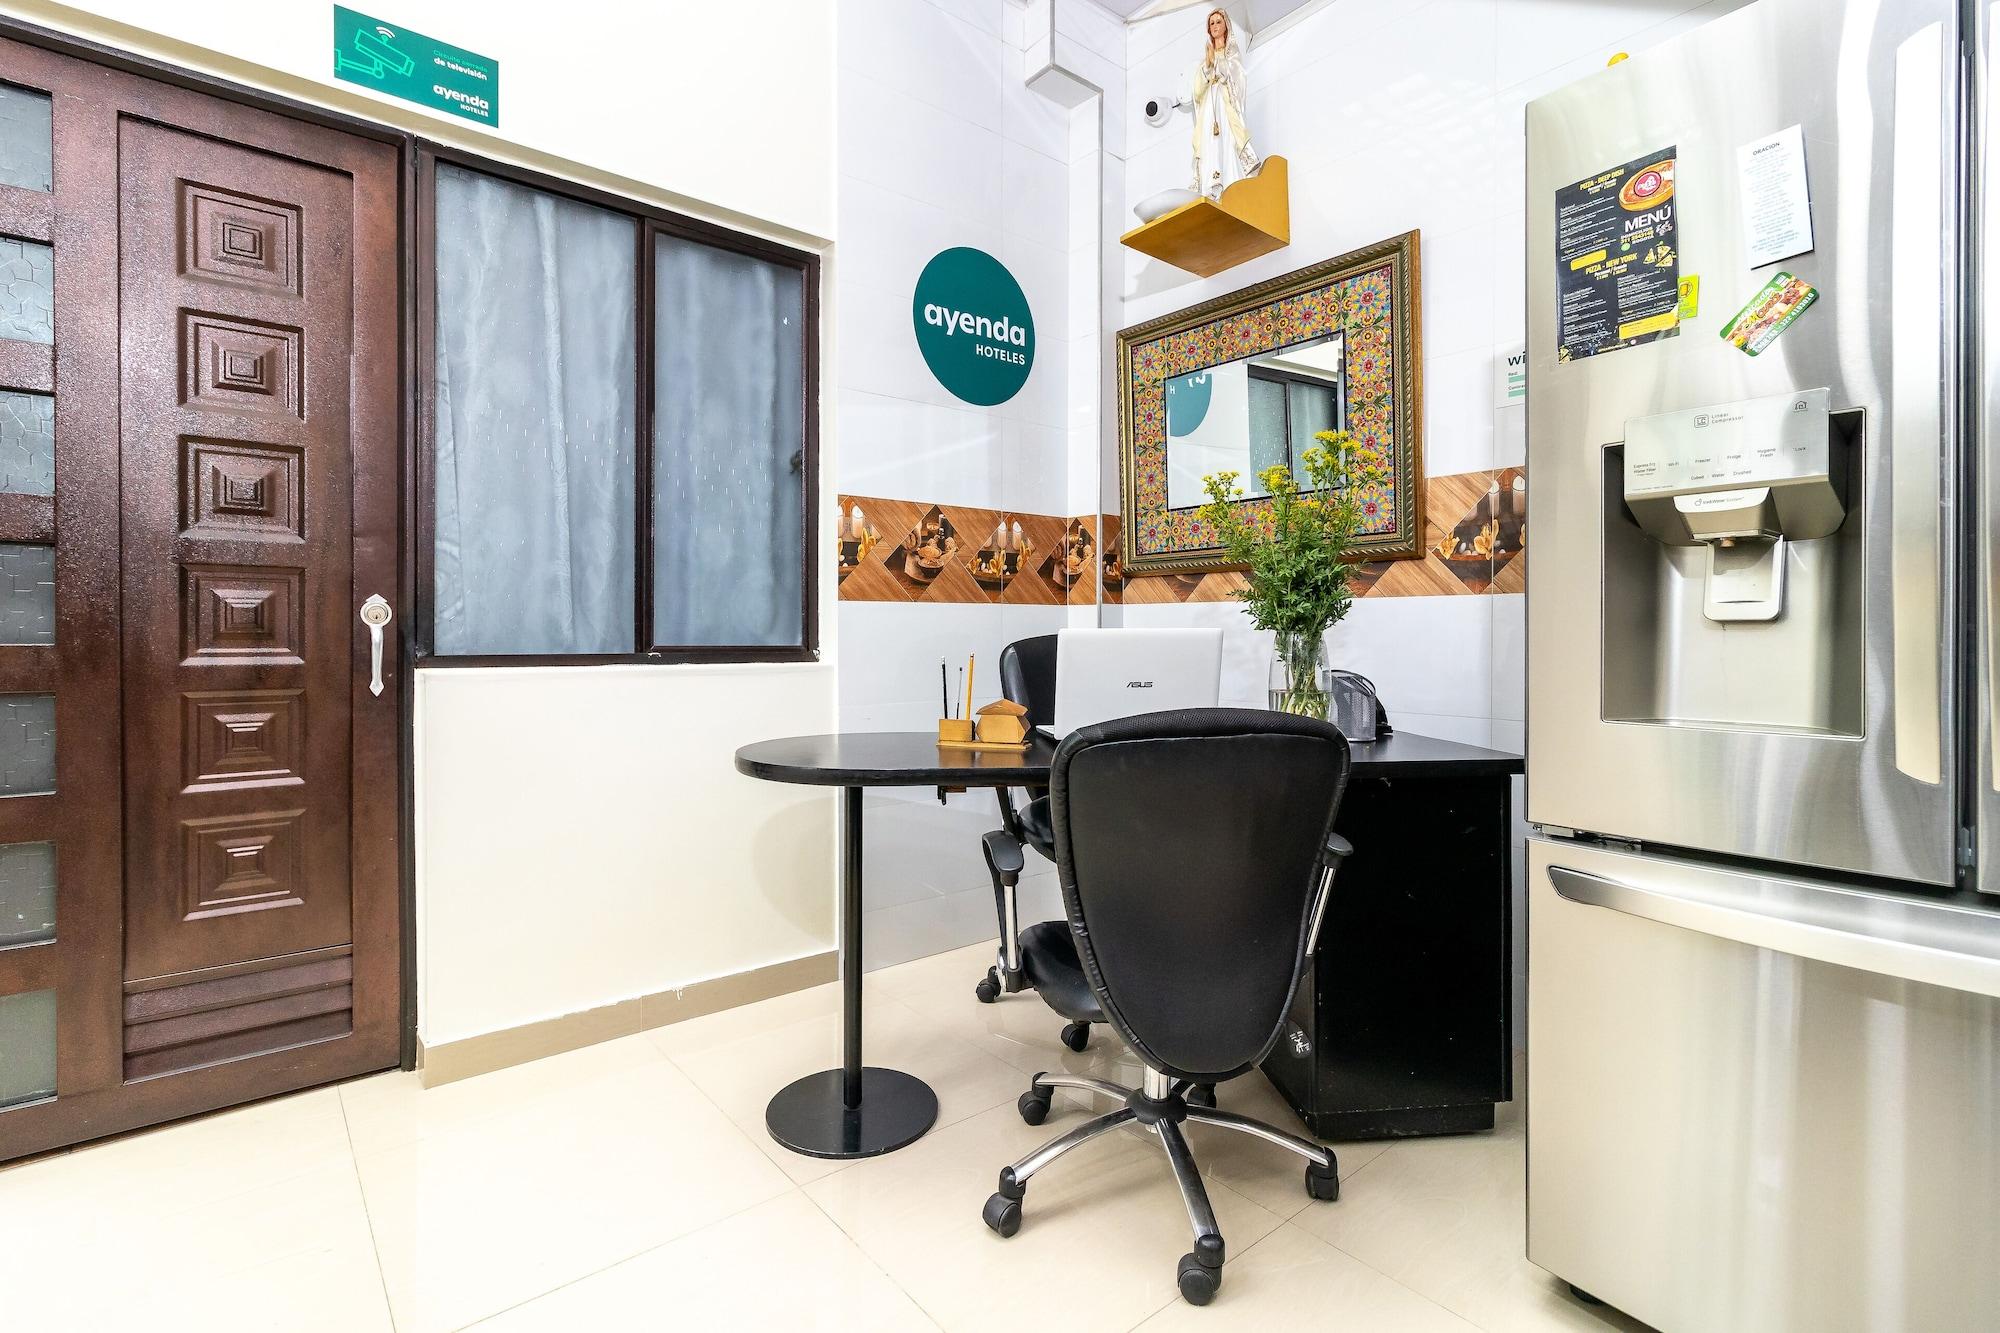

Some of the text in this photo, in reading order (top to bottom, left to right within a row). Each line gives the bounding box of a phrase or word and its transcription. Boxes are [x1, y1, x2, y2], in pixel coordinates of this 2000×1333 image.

[433, 49, 460, 63] Circuito
[433, 57, 488, 81] de televisión
[433, 84, 489, 110] ayenda
[460, 103, 489, 118] HOTELES
[1752, 142, 1780, 156] ORACION
[1580, 180, 1594, 190] PIZZA
[1598, 173, 1611, 183] DEEP
[1611, 168, 1624, 179] DISH
[1625, 204, 1672, 233] MENÚ
[1585, 263, 1601, 275] PIZZA
[1606, 257, 1620, 269] NEW
[1620, 252, 1638, 264] YORK
[924, 303, 1026, 347] ayenda
[975, 343, 1026, 366] HOTELES
[1508, 351, 1526, 366] wi
[1711, 416, 1744, 424] Compressor
